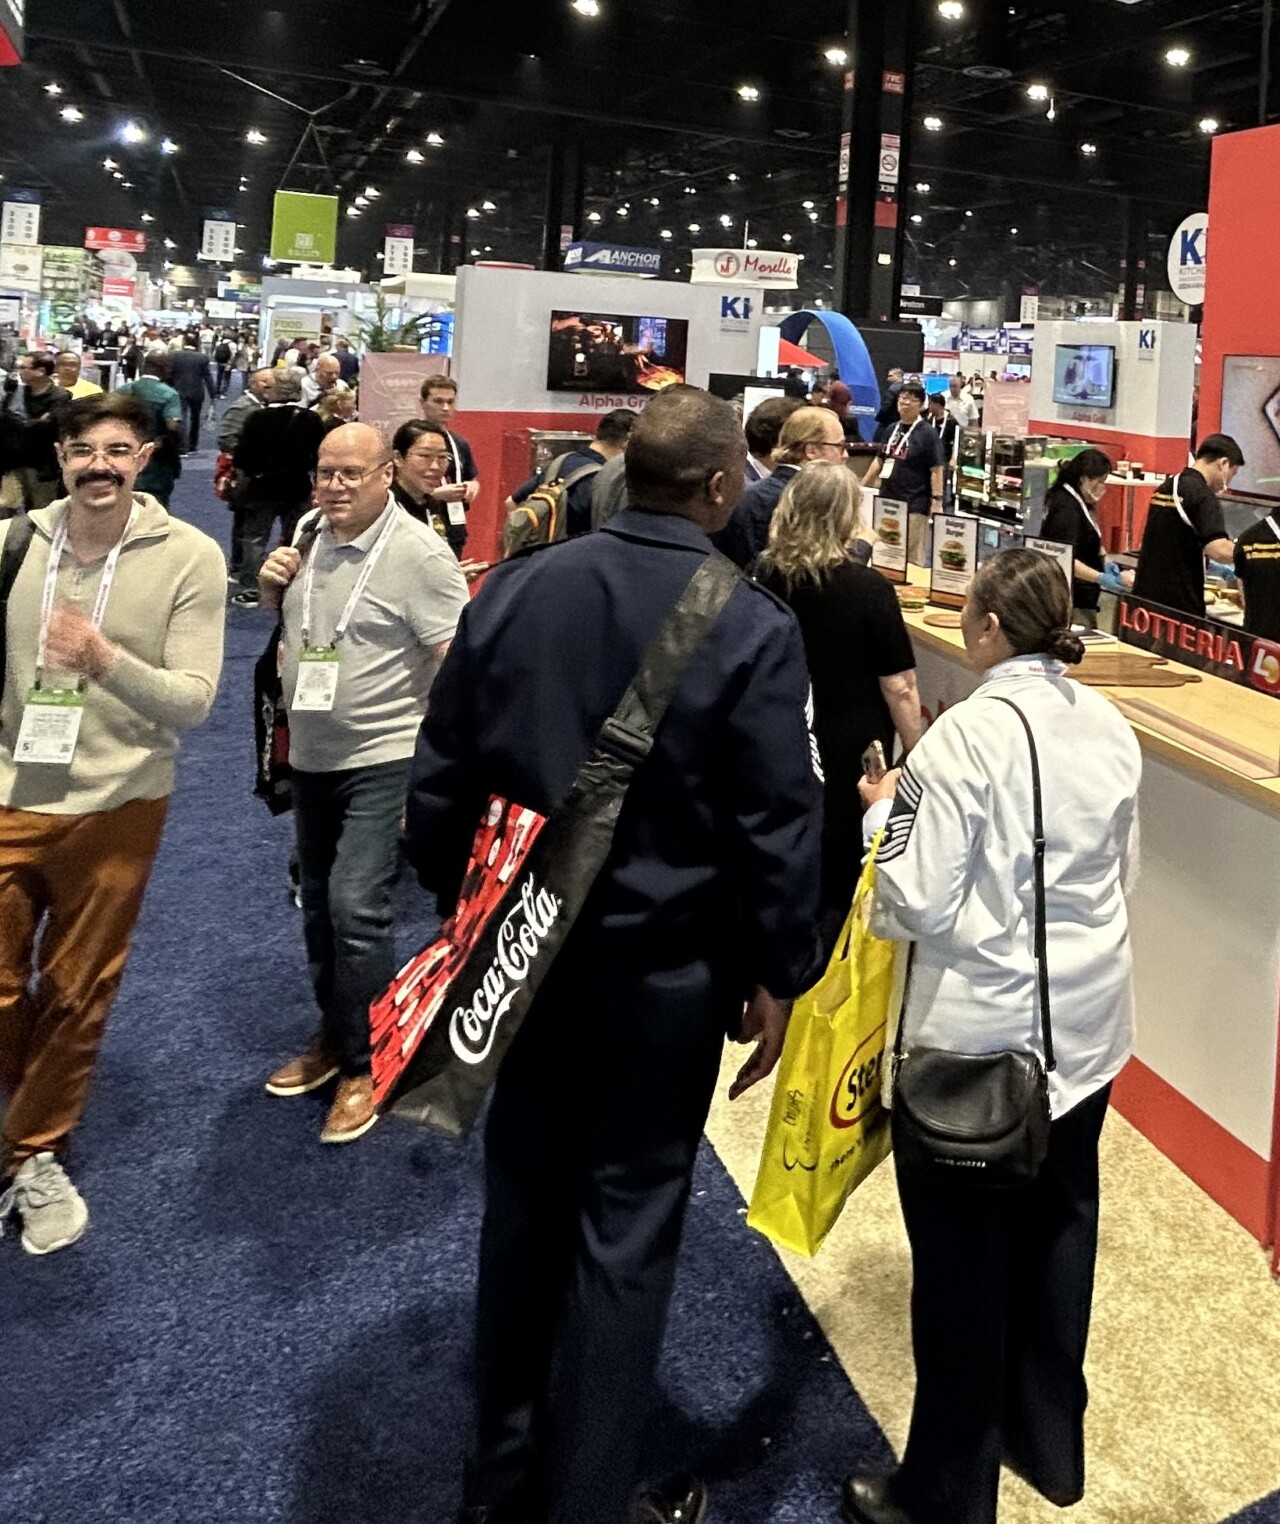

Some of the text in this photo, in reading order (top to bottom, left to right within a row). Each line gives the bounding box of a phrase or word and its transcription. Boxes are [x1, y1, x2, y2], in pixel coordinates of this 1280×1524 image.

[611, 250, 661, 263] ANCHOR
[579, 393, 623, 409] Alpha
[1120, 601, 1244, 671] LOTTERIA
[449, 872, 562, 1065] Coca-Cola
